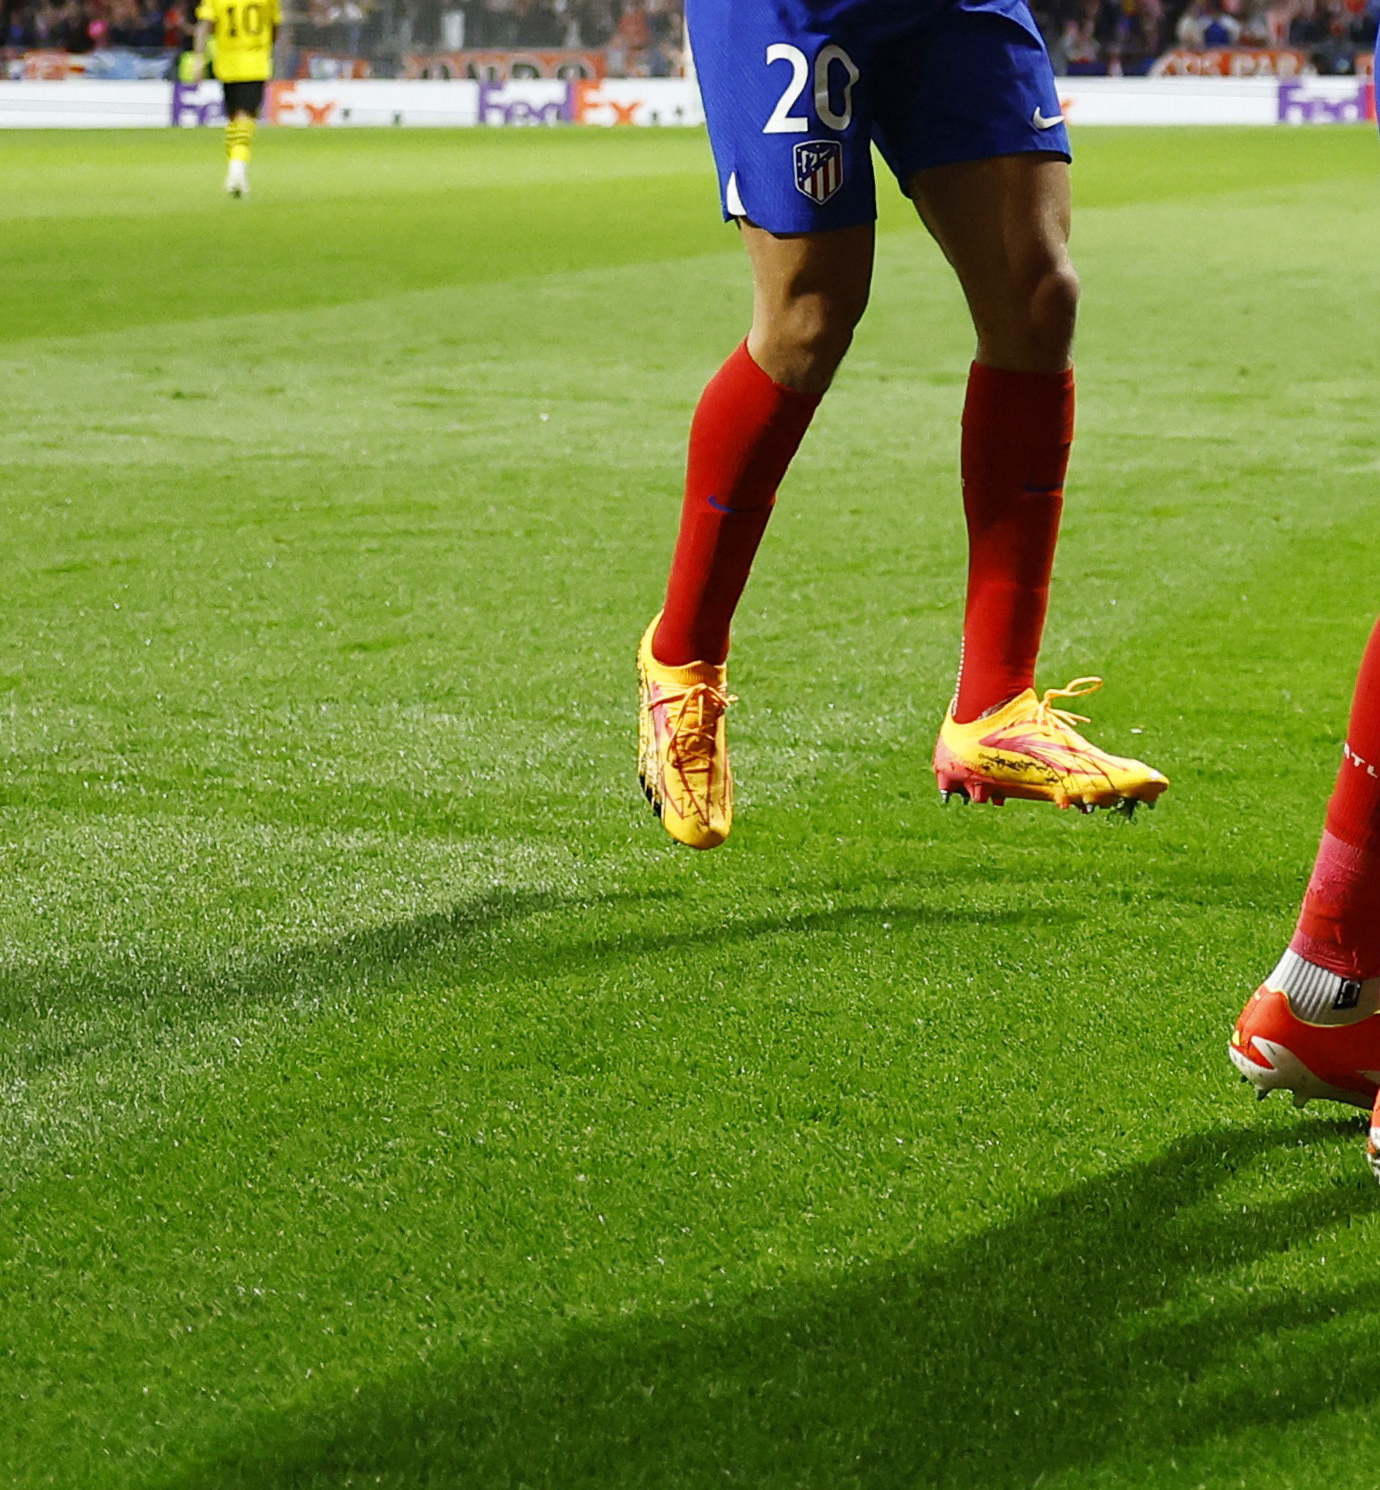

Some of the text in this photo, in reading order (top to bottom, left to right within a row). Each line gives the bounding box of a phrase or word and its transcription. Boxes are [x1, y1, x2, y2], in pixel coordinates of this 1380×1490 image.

[225, 3, 266, 38] 10
[172, 79, 335, 126] FeEx
[762, 43, 860, 134] 20
[1278, 84, 1375, 123] Fed
